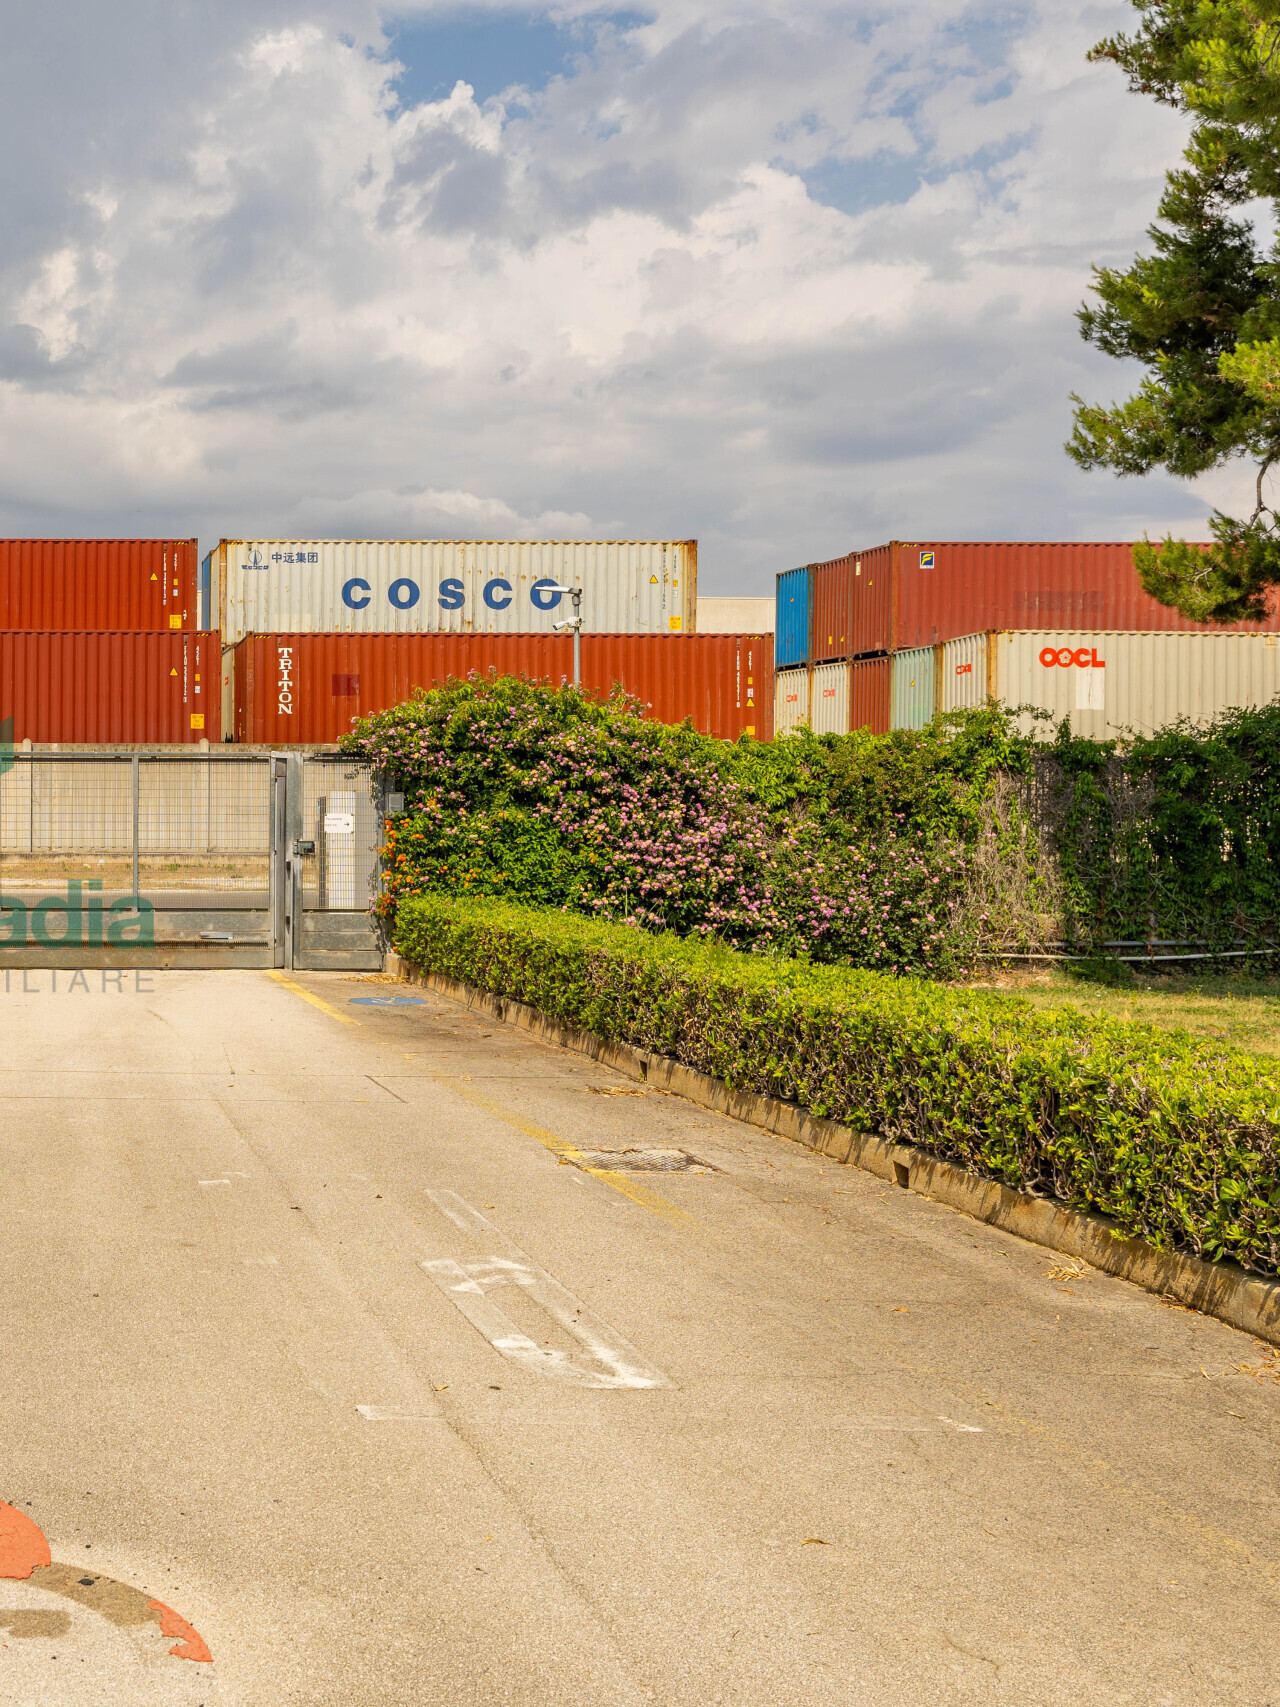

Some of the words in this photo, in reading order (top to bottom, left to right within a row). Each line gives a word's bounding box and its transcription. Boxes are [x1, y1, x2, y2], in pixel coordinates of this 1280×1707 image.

[272, 552, 318, 563] 中远集团
[342, 578, 562, 610] COSCO
[1039, 647, 1105, 668] OOCL
[278, 647, 293, 714] TRITON
